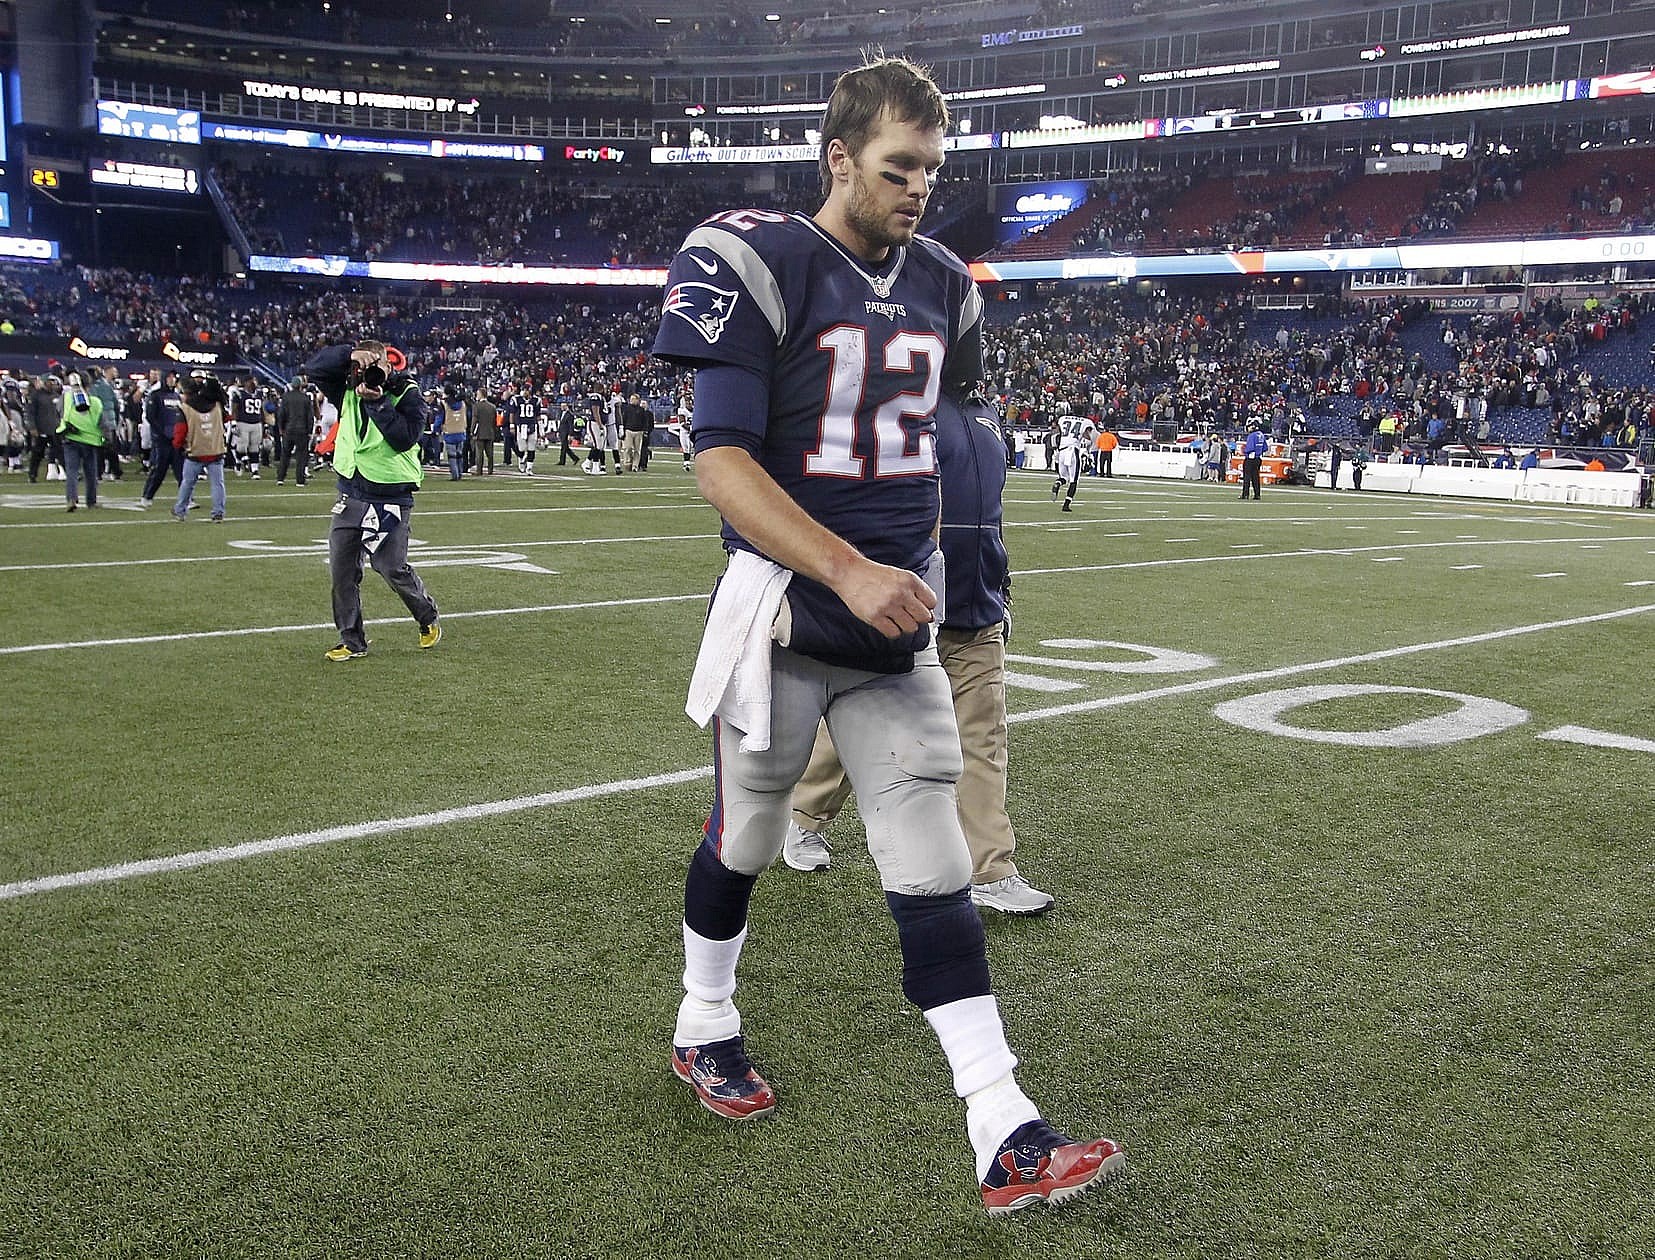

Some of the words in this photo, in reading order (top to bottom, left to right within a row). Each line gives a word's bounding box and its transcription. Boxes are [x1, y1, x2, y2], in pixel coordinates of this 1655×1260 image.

[1401, 42, 1441, 53] POWERING
[1442, 40, 1457, 49] THE
[1517, 26, 1570, 40] REVOLUTION
[1139, 71, 1172, 82] POWERING
[1173, 69, 1185, 79] THE
[243, 81, 300, 100] TODAY'S
[301, 87, 341, 104] GAME
[343, 91, 357, 106] IS
[359, 92, 434, 111] PRESENTED
[436, 98, 455, 112] BY
[666, 148, 712, 162] Gillette
[718, 149, 737, 160] OUT
[740, 149, 752, 160] OF
[754, 148, 783, 159] TOWN
[786, 147, 818, 159] SCORE
[32, 169, 57, 187] 25
[864, 301, 907, 317] PATRIOTS
[1451, 299, 1480, 308] 2007
[520, 403, 534, 417] 10
[803, 323, 947, 480] 12
[1062, 420, 1082, 440] 34
